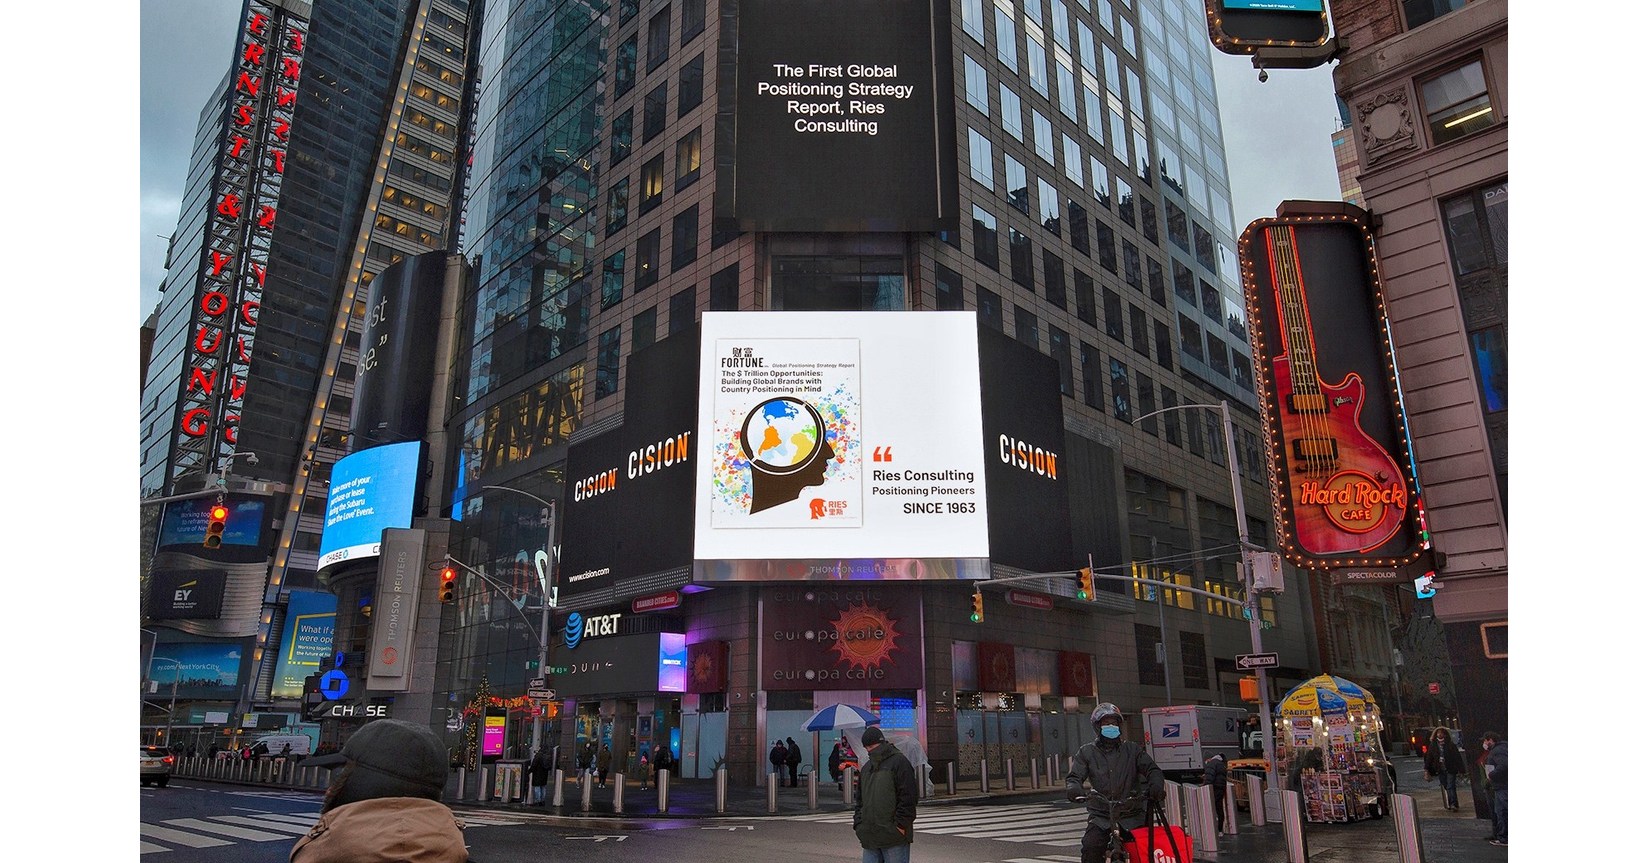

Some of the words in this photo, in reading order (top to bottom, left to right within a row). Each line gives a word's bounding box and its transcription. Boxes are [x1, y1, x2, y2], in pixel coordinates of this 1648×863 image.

[773, 64, 804, 77] The
[808, 64, 843, 77] First
[847, 64, 897, 77] Global
[230, 13, 268, 158] ERNST
[758, 82, 843, 98] Positioning
[848, 82, 913, 98] Strategy
[787, 100, 844, 116] Report,
[849, 100, 885, 114] Ries
[794, 119, 878, 135] Consulting
[217, 193, 242, 218] &
[181, 251, 233, 436] YOUNG
[721, 357, 764, 368] FORTUNE
[770, 370, 823, 379] Opportunities:
[721, 378, 752, 386] Building
[721, 386, 750, 394] Country
[752, 386, 794, 394] Positioning
[628, 431, 691, 479] CISION
[1000, 433, 1057, 480] CISION
[873, 470, 901, 481] Ries
[904, 470, 974, 483] Consulting
[574, 467, 618, 502] CISION
[872, 486, 929, 497] Positioning
[931, 486, 975, 495] Pioneers
[1301, 481, 1352, 504] Hard
[1355, 481, 1407, 509] Rock
[828, 500, 848, 509] RIES
[903, 502, 943, 514] SINCE
[946, 502, 976, 514] 1963
[1341, 509, 1372, 520] CAFE
[326, 552, 342, 563] CHASE
[393, 551, 407, 593] REUTERS
[569, 567, 610, 582] www.cision.com
[810, 566, 854, 574] THOMSON
[1347, 571, 1397, 579] SPECTACOLOR
[174, 590, 192, 601] EY
[388, 595, 402, 642] THOMSON
[300, 625, 321, 634] What
[323, 626, 330, 634] if
[583, 613, 621, 638] AT&T
[299, 634, 318, 643] were
[774, 630, 839, 642] europa
[774, 670, 840, 682] europa
[332, 705, 387, 717] CHASE
